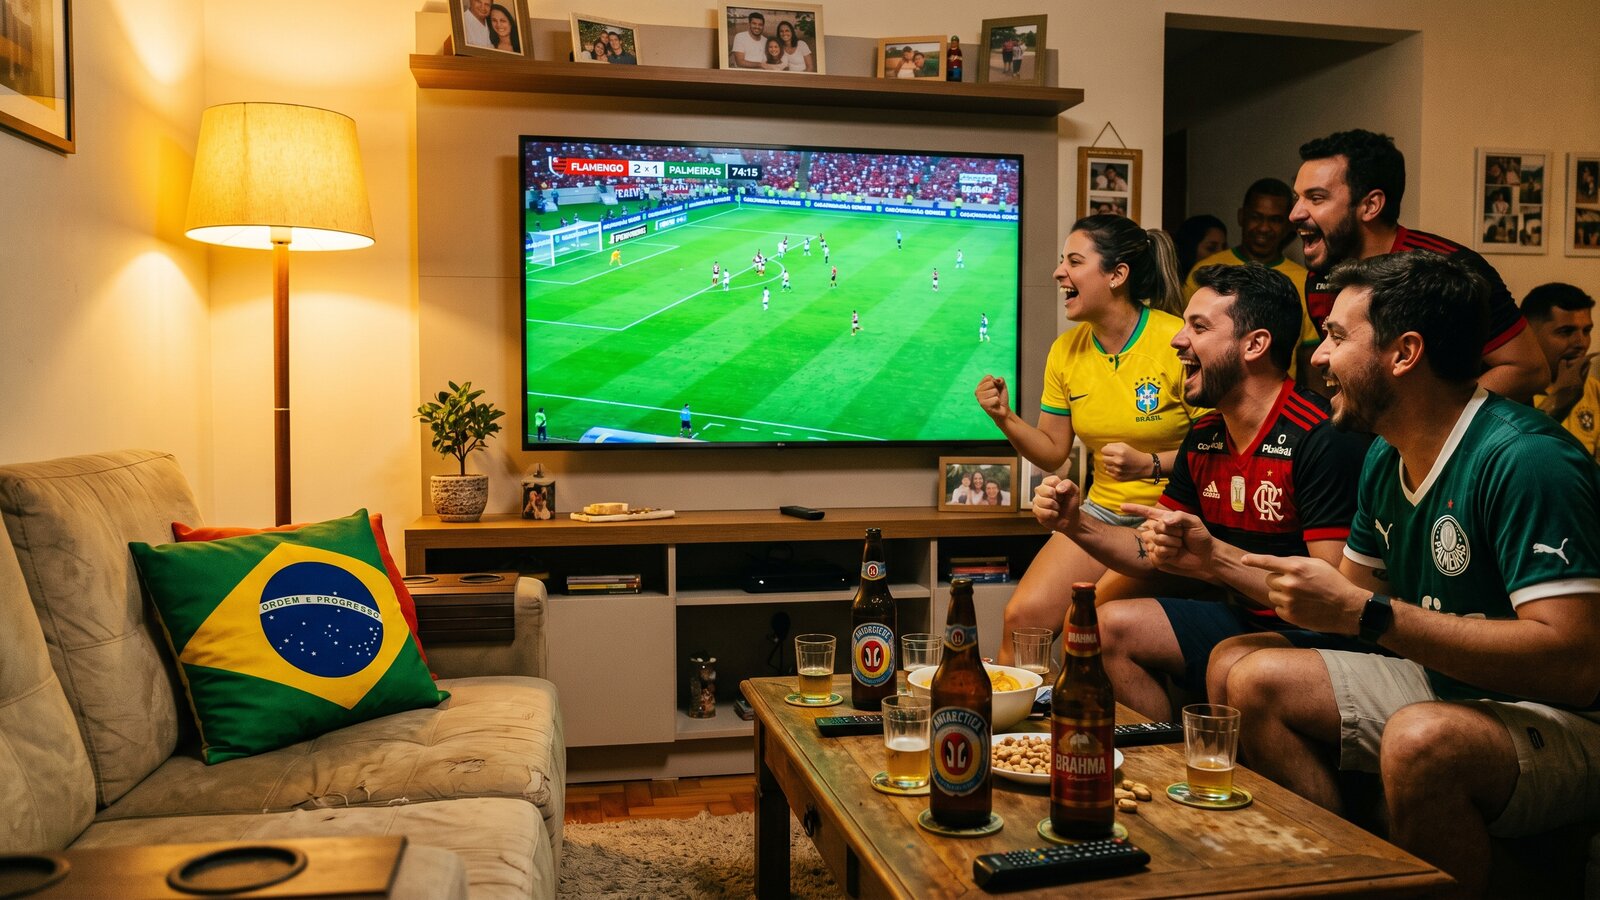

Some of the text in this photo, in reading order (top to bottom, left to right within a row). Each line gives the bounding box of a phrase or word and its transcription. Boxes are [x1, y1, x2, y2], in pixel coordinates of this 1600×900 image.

[570, 162, 624, 174] FLAMENGO
[633, 164, 641, 174] 2
[652, 164, 658, 174] 1
[668, 165, 722, 176] PALMEIRAS
[731, 167, 759, 177] 74:15
[1434, 541, 1466, 571] PALMEIRAS
[261, 596, 300, 611] ORDEM
[316, 596, 380, 619] PROGRESSO
[1067, 631, 1097, 643] BRAHMA
[933, 711, 983, 732] ANTARCTICA
[1055, 753, 1107, 775] BRAHMA
